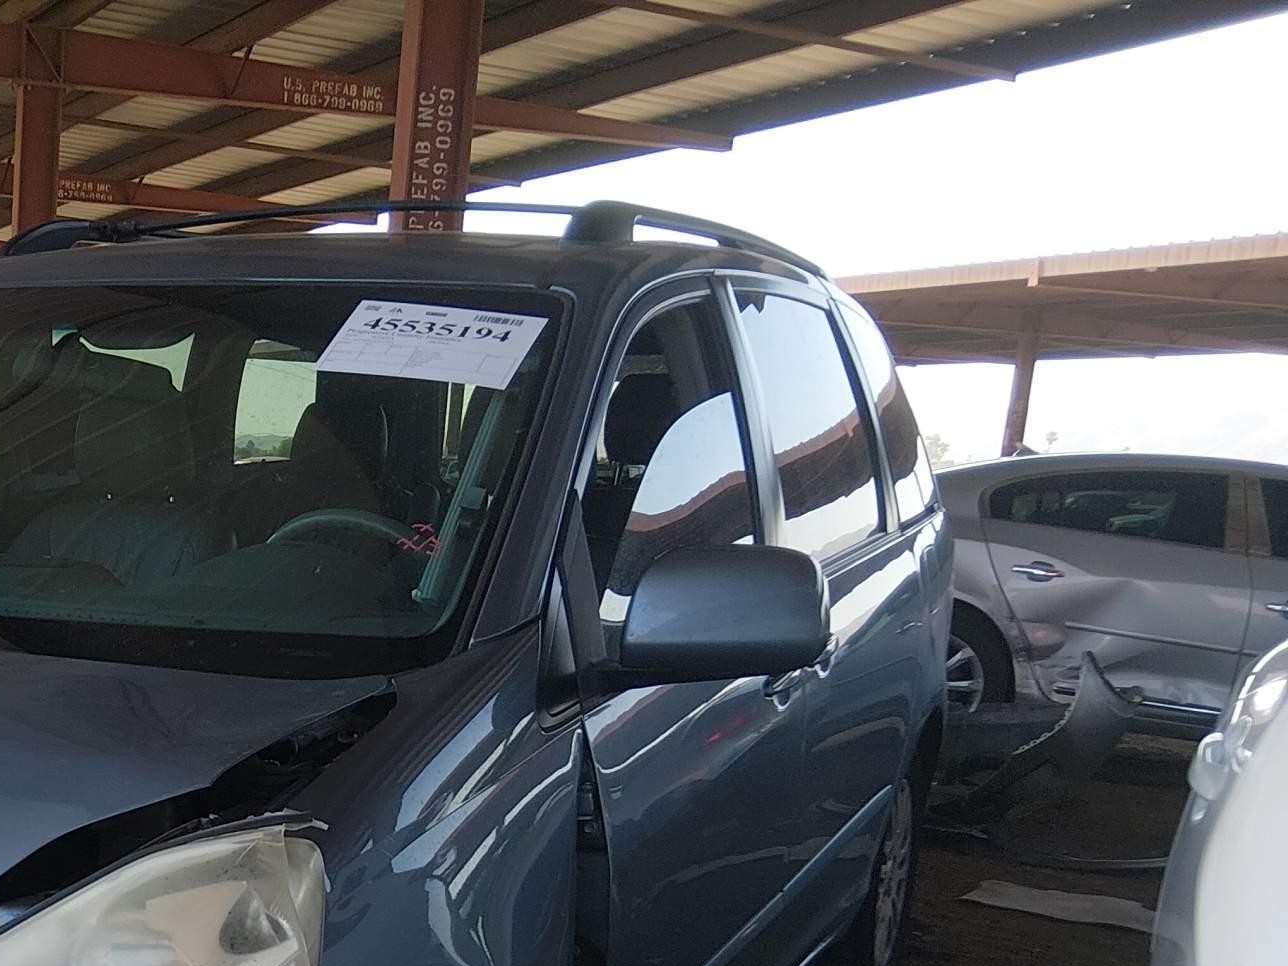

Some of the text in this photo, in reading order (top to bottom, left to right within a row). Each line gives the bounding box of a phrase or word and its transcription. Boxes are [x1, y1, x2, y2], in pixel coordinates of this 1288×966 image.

[283, 76, 385, 100] U.S. PREFAB INC.
[408, 85, 438, 230] PEFAB INC.
[362, 316, 512, 343] 45535194
